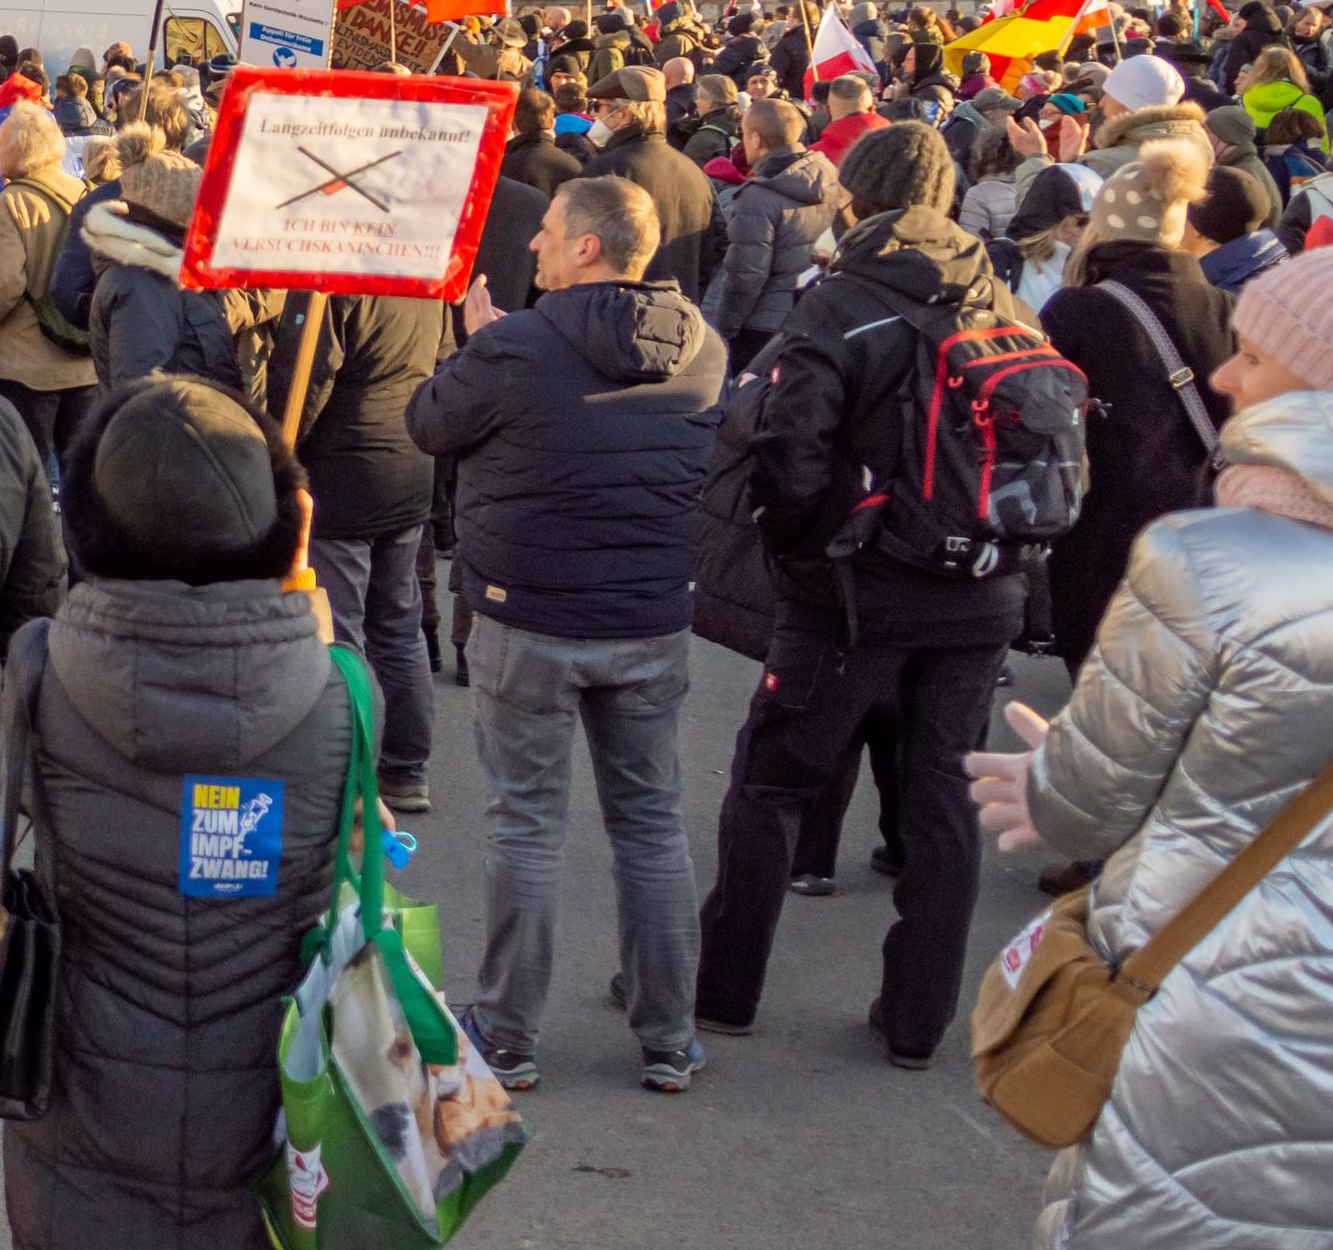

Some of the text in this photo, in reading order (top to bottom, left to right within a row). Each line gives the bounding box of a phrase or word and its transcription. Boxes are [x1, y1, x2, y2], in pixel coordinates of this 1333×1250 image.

[284, 30, 295, 40] für
[295, 33, 312, 44] freie
[260, 118, 471, 144] Langzeitfolgen unbekannt!
[284, 217, 397, 236] ICH BIN KEIN
[232, 235, 440, 259] VERSUCHSKANINCHEN!!!
[194, 783, 240, 809] NEIN
[192, 809, 239, 835] ZUM
[191, 832, 252, 859] IMPF-
[190, 856, 269, 879] ZWANG!
